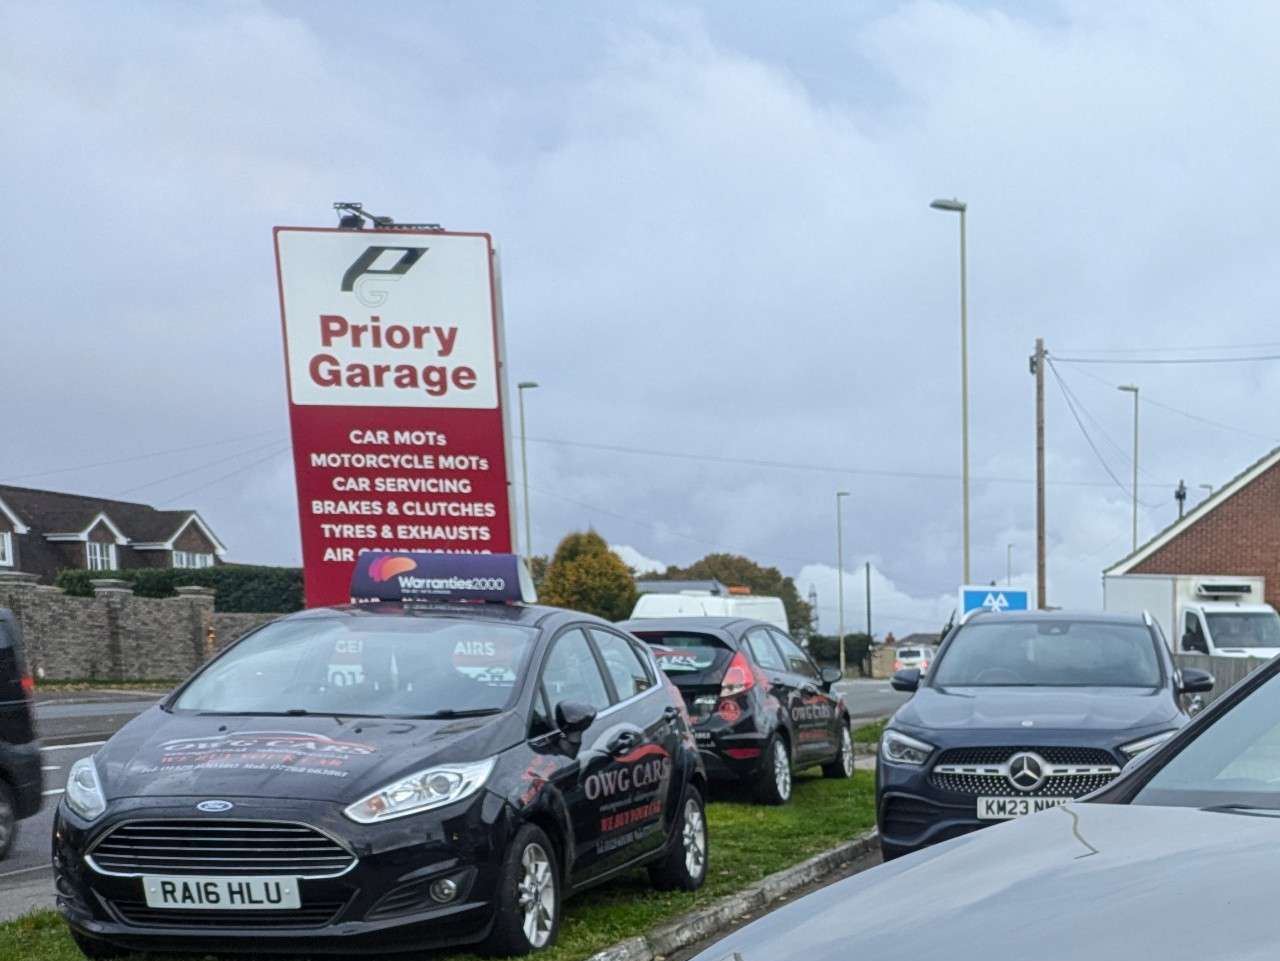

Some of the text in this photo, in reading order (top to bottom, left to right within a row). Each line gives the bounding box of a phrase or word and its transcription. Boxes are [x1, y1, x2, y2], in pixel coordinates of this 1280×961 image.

[319, 314, 458, 357] Priory
[309, 353, 477, 397] Garage
[349, 430, 447, 446] CAR MOTs
[310, 453, 489, 471] MOTORCYCLE MOTs
[332, 477, 472, 494] CAR SERVICING
[311, 500, 496, 518] BRAKES & CLUTCHES
[320, 523, 491, 541] TYRES & EXHAUSTS
[323, 547, 354, 562] AIR
[398, 576, 505, 592] Warranties2000
[584, 757, 672, 800] OWG CARS
[985, 799, 1029, 816] KM23
[160, 880, 283, 905] RA16 HLU
